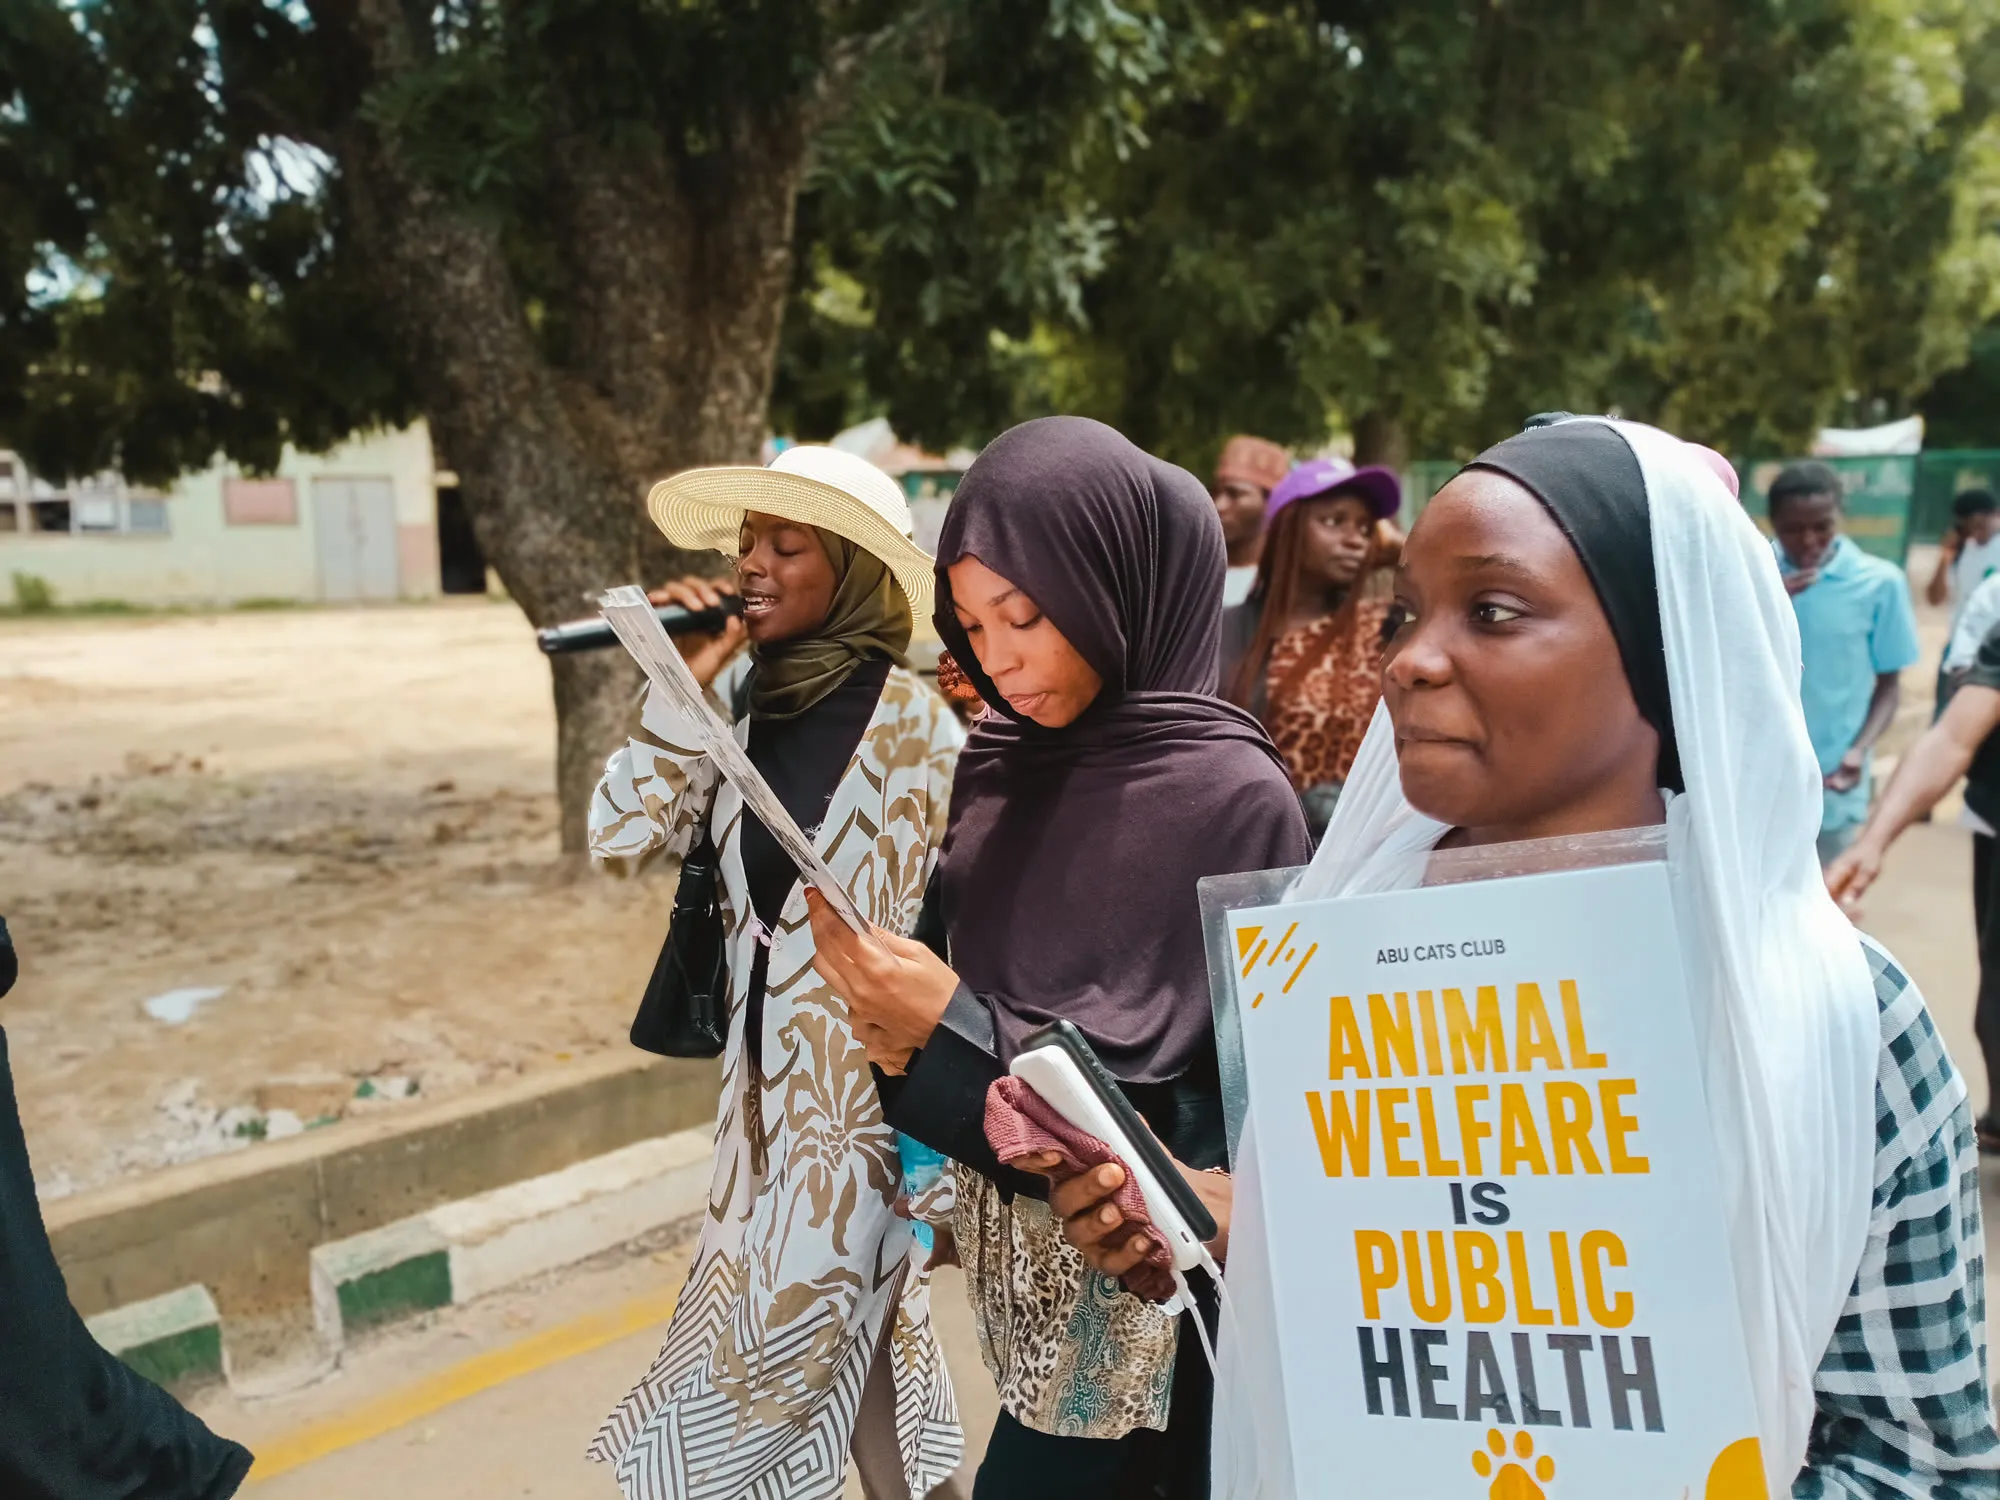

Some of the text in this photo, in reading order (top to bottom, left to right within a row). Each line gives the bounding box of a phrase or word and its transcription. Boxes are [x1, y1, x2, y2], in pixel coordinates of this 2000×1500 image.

[1376, 939, 1505, 964] ABU CATS CLUB
[1328, 979, 1608, 1081] ANIMAL
[1305, 1077, 1651, 1178] WELFARE
[1449, 1181, 1511, 1225] IS
[1353, 1229, 1635, 1329] PUBLIC
[1356, 1325, 1666, 1433] HEALTH
